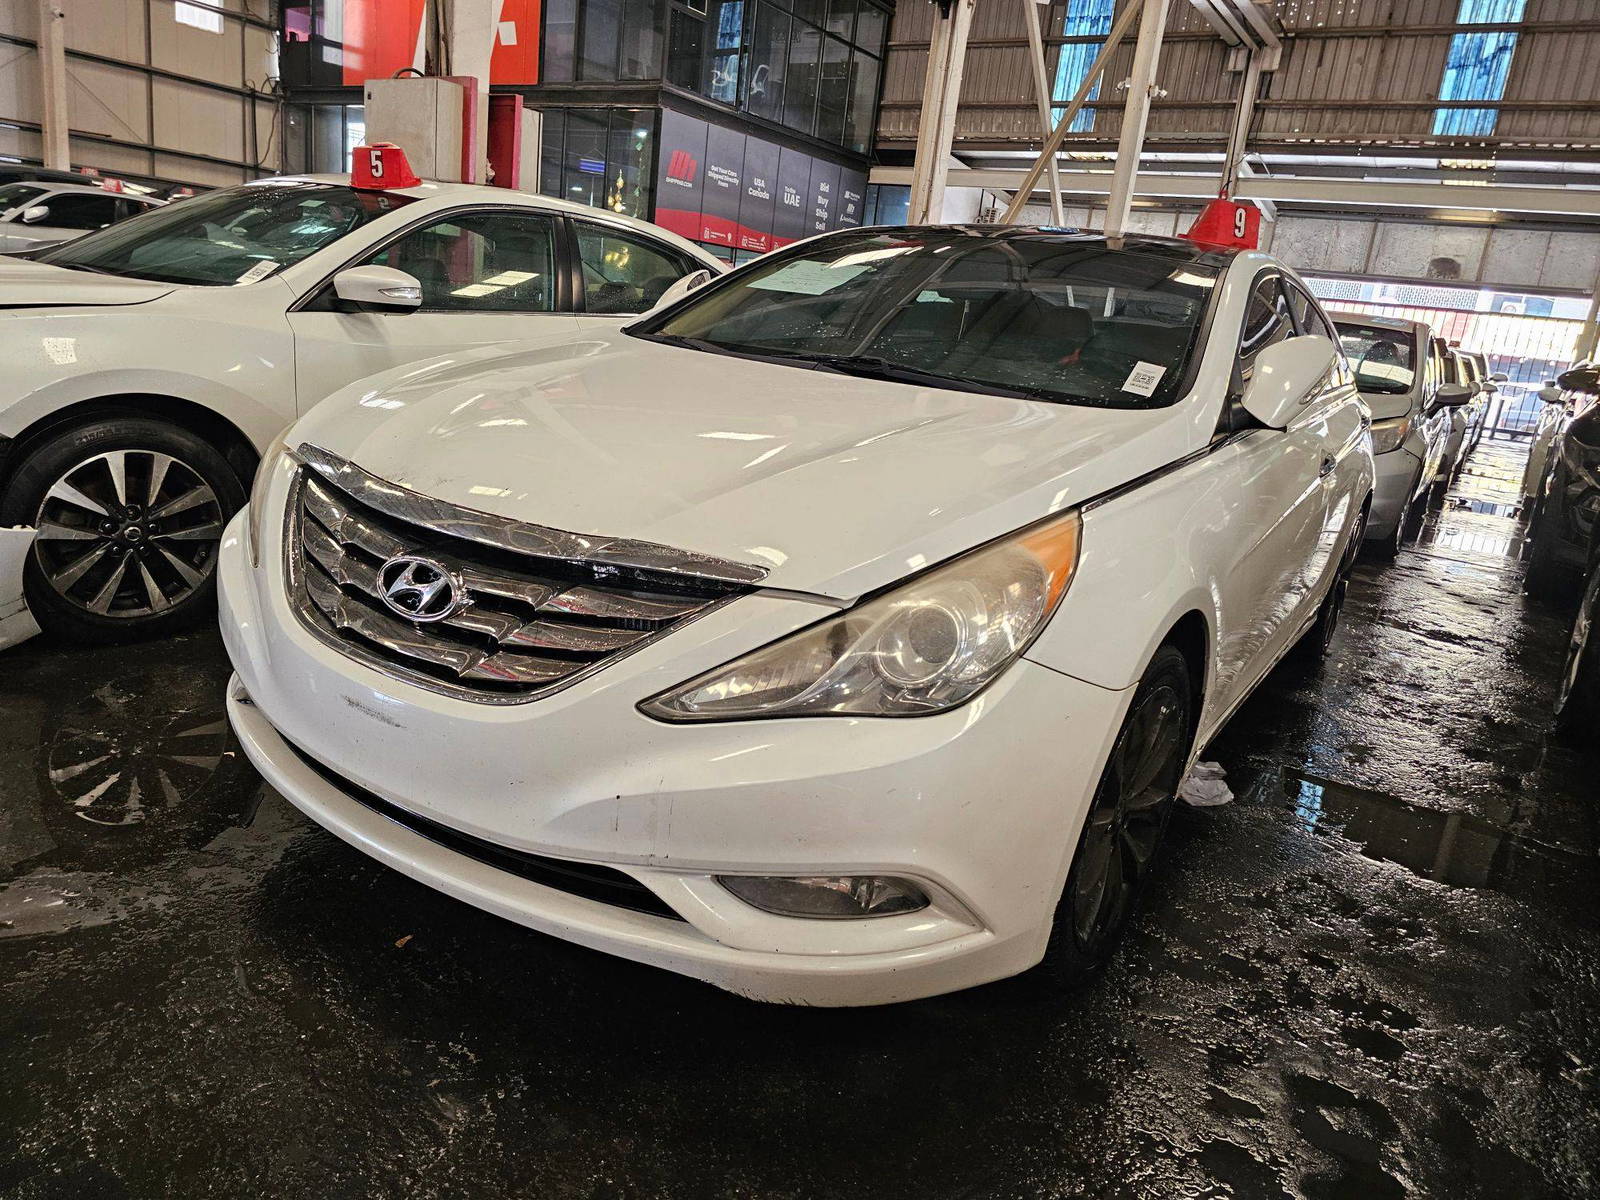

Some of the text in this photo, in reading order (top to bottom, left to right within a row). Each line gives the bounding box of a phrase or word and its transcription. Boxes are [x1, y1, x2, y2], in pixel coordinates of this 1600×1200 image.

[370, 150, 383, 177] 5
[754, 177, 765, 188] USA
[819, 182, 830, 193] Bid
[748, 187, 770, 200] Canada
[784, 192, 800, 207] UAE
[817, 195, 829, 208] Buy
[816, 208, 828, 220] Ship
[815, 221, 826, 231] Sell
[1234, 207, 1246, 238] 9
